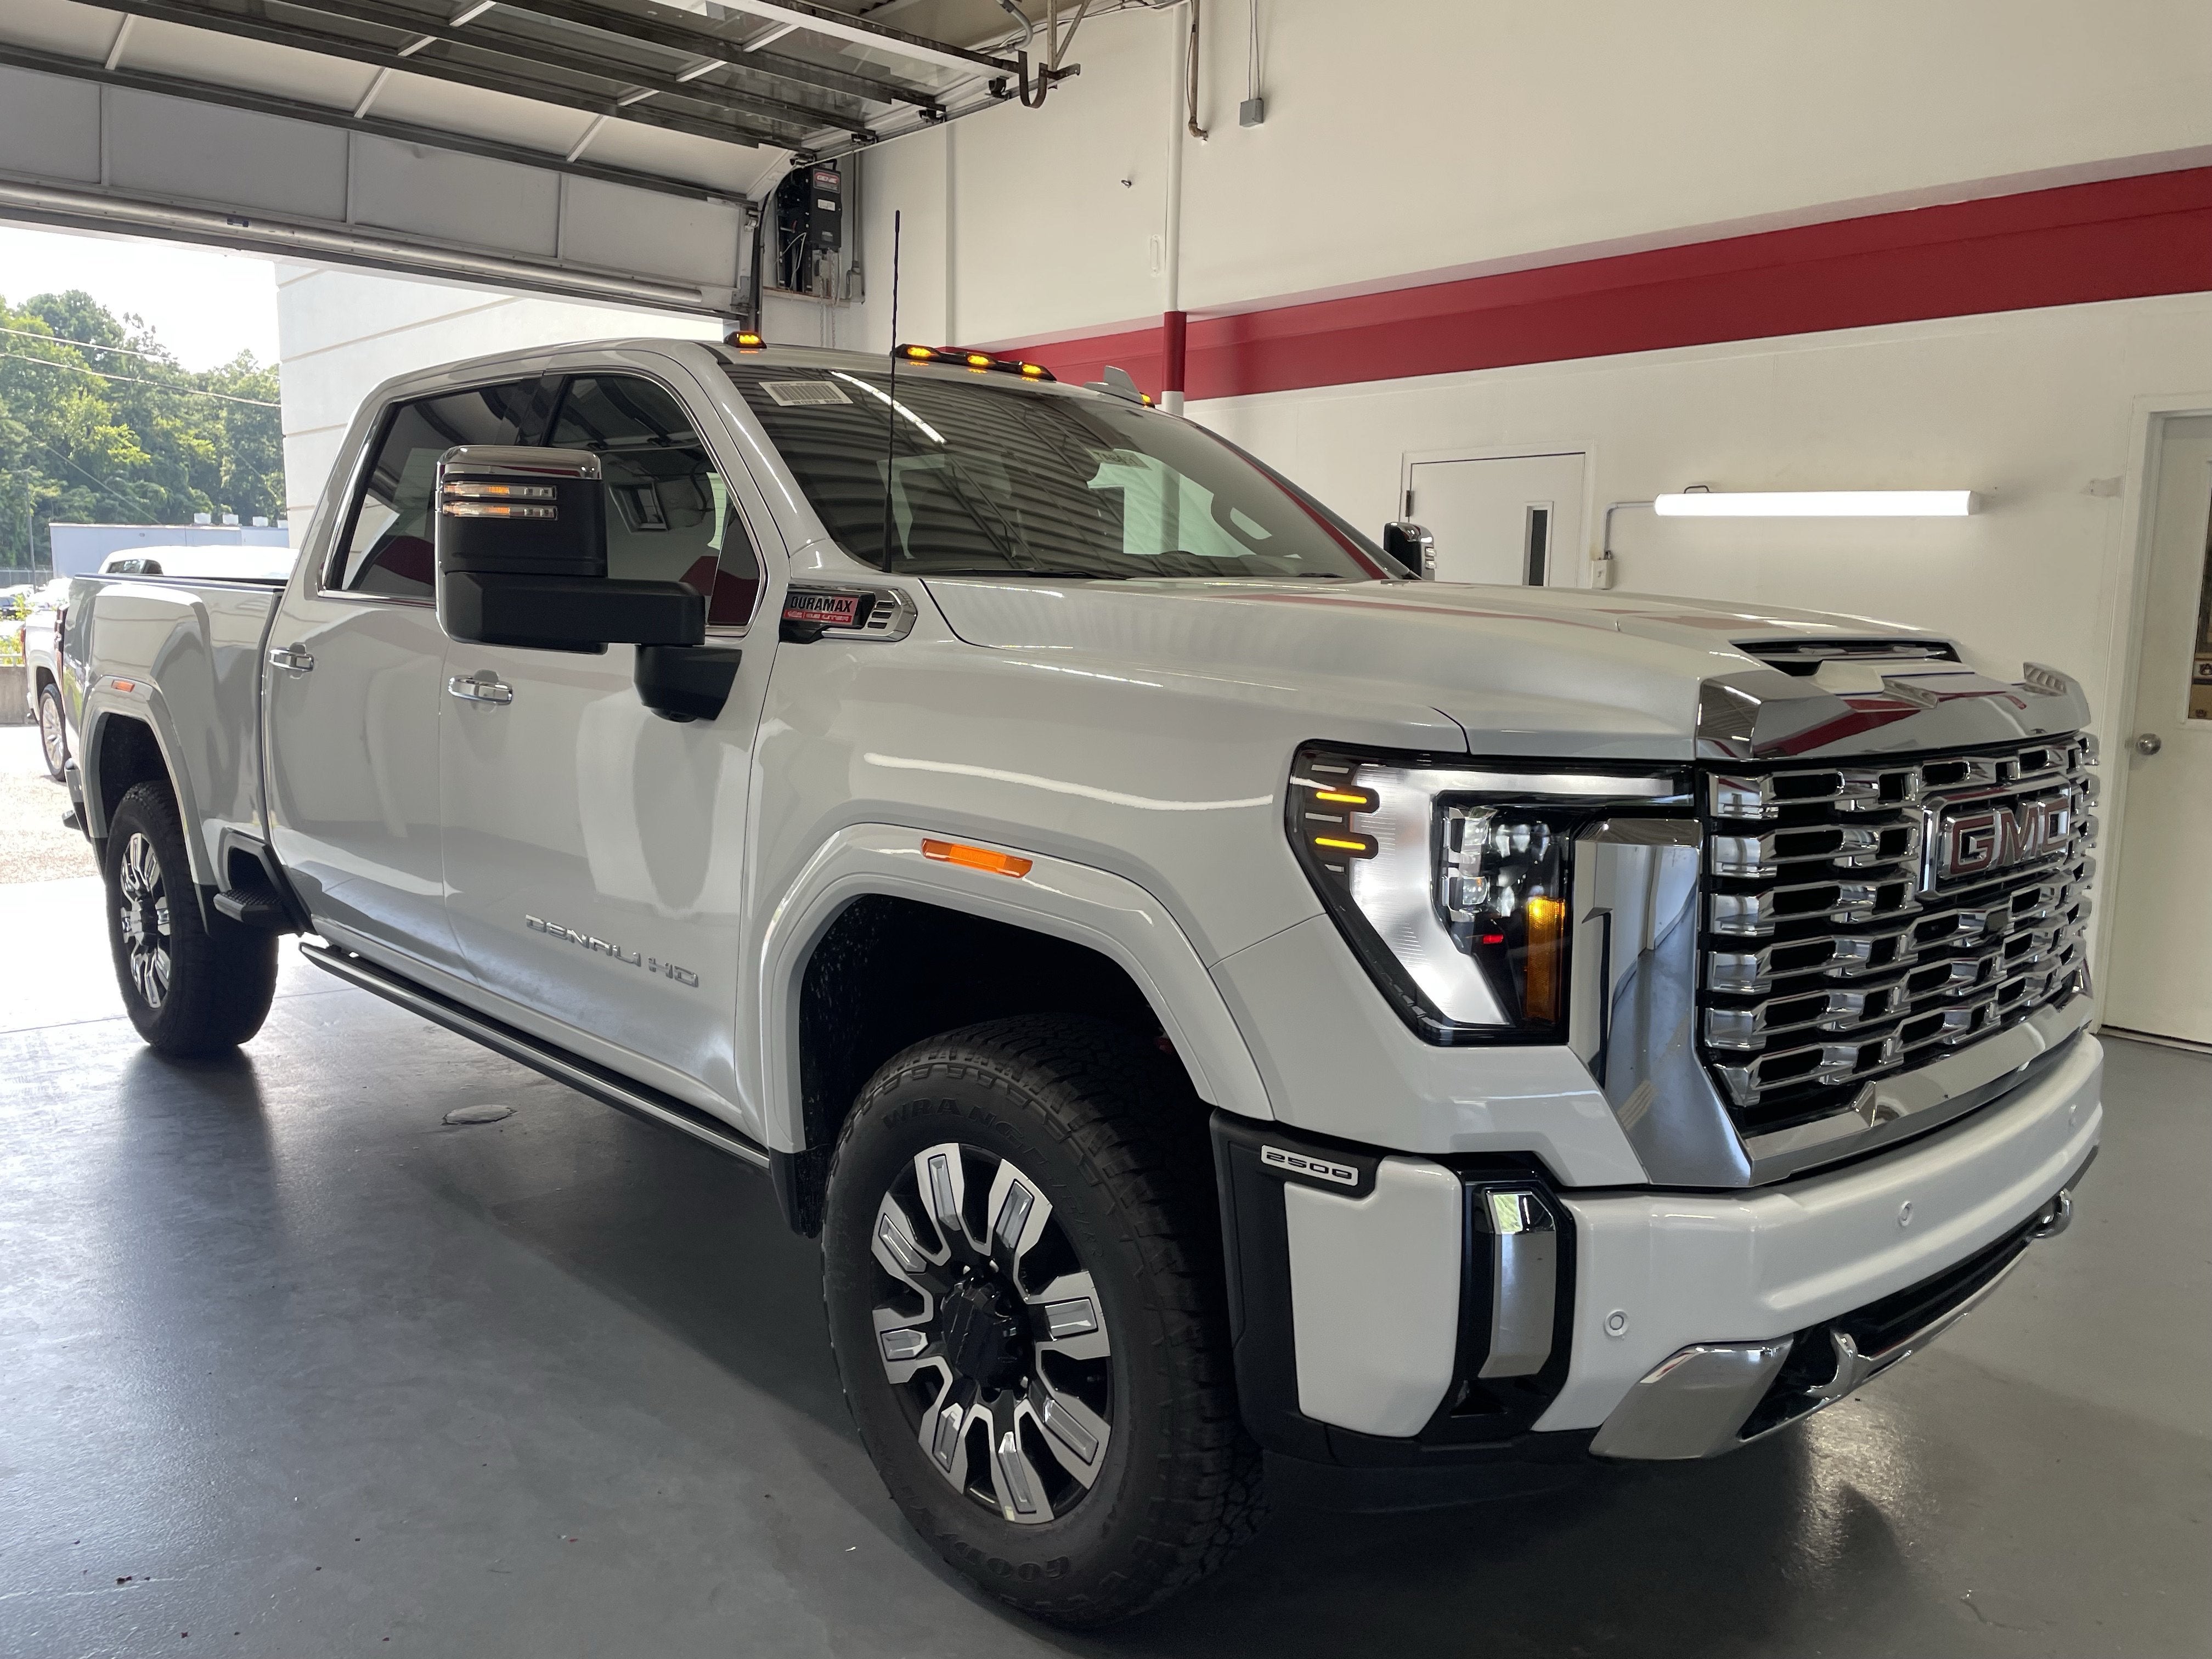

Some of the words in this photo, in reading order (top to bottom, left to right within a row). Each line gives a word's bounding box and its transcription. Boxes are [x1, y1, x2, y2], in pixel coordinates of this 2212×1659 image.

[790, 596, 853, 613] DURAMAX
[1941, 796, 2071, 878] GMC
[525, 913, 641, 967] DENALI
[648, 957, 699, 988] HD
[882, 1097, 1104, 1257] WRANGLER
[1266, 1152, 1352, 1180] 2500
